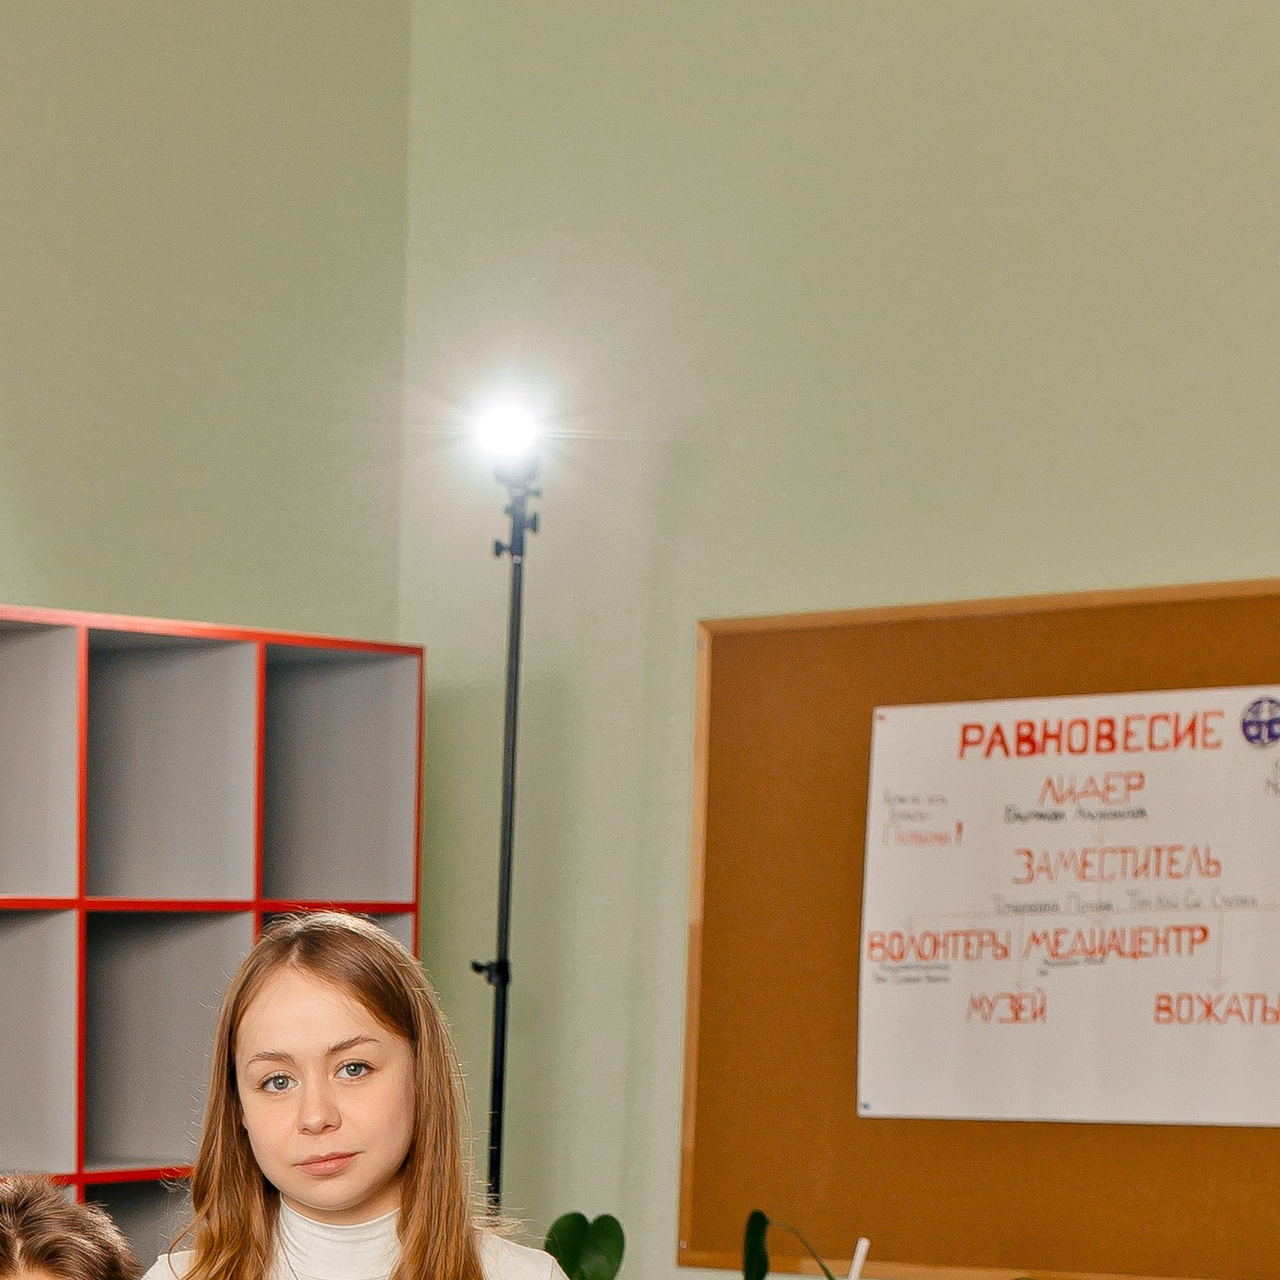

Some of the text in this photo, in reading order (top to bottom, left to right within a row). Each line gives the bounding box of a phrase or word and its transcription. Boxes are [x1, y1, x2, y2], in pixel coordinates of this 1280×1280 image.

[959, 711, 1224, 759] РАВНОВЕСИЕ
[1039, 770, 1146, 806] ЛИДЕР
[1012, 843, 1223, 885] ЗАМЕСТИТЕЛЬ
[867, 928, 1012, 962] ВОЛОНТЕРЫ
[1022, 924, 1210, 962] МЕДИАЦЕНТР
[965, 986, 1048, 1024] МУЗЕЙ
